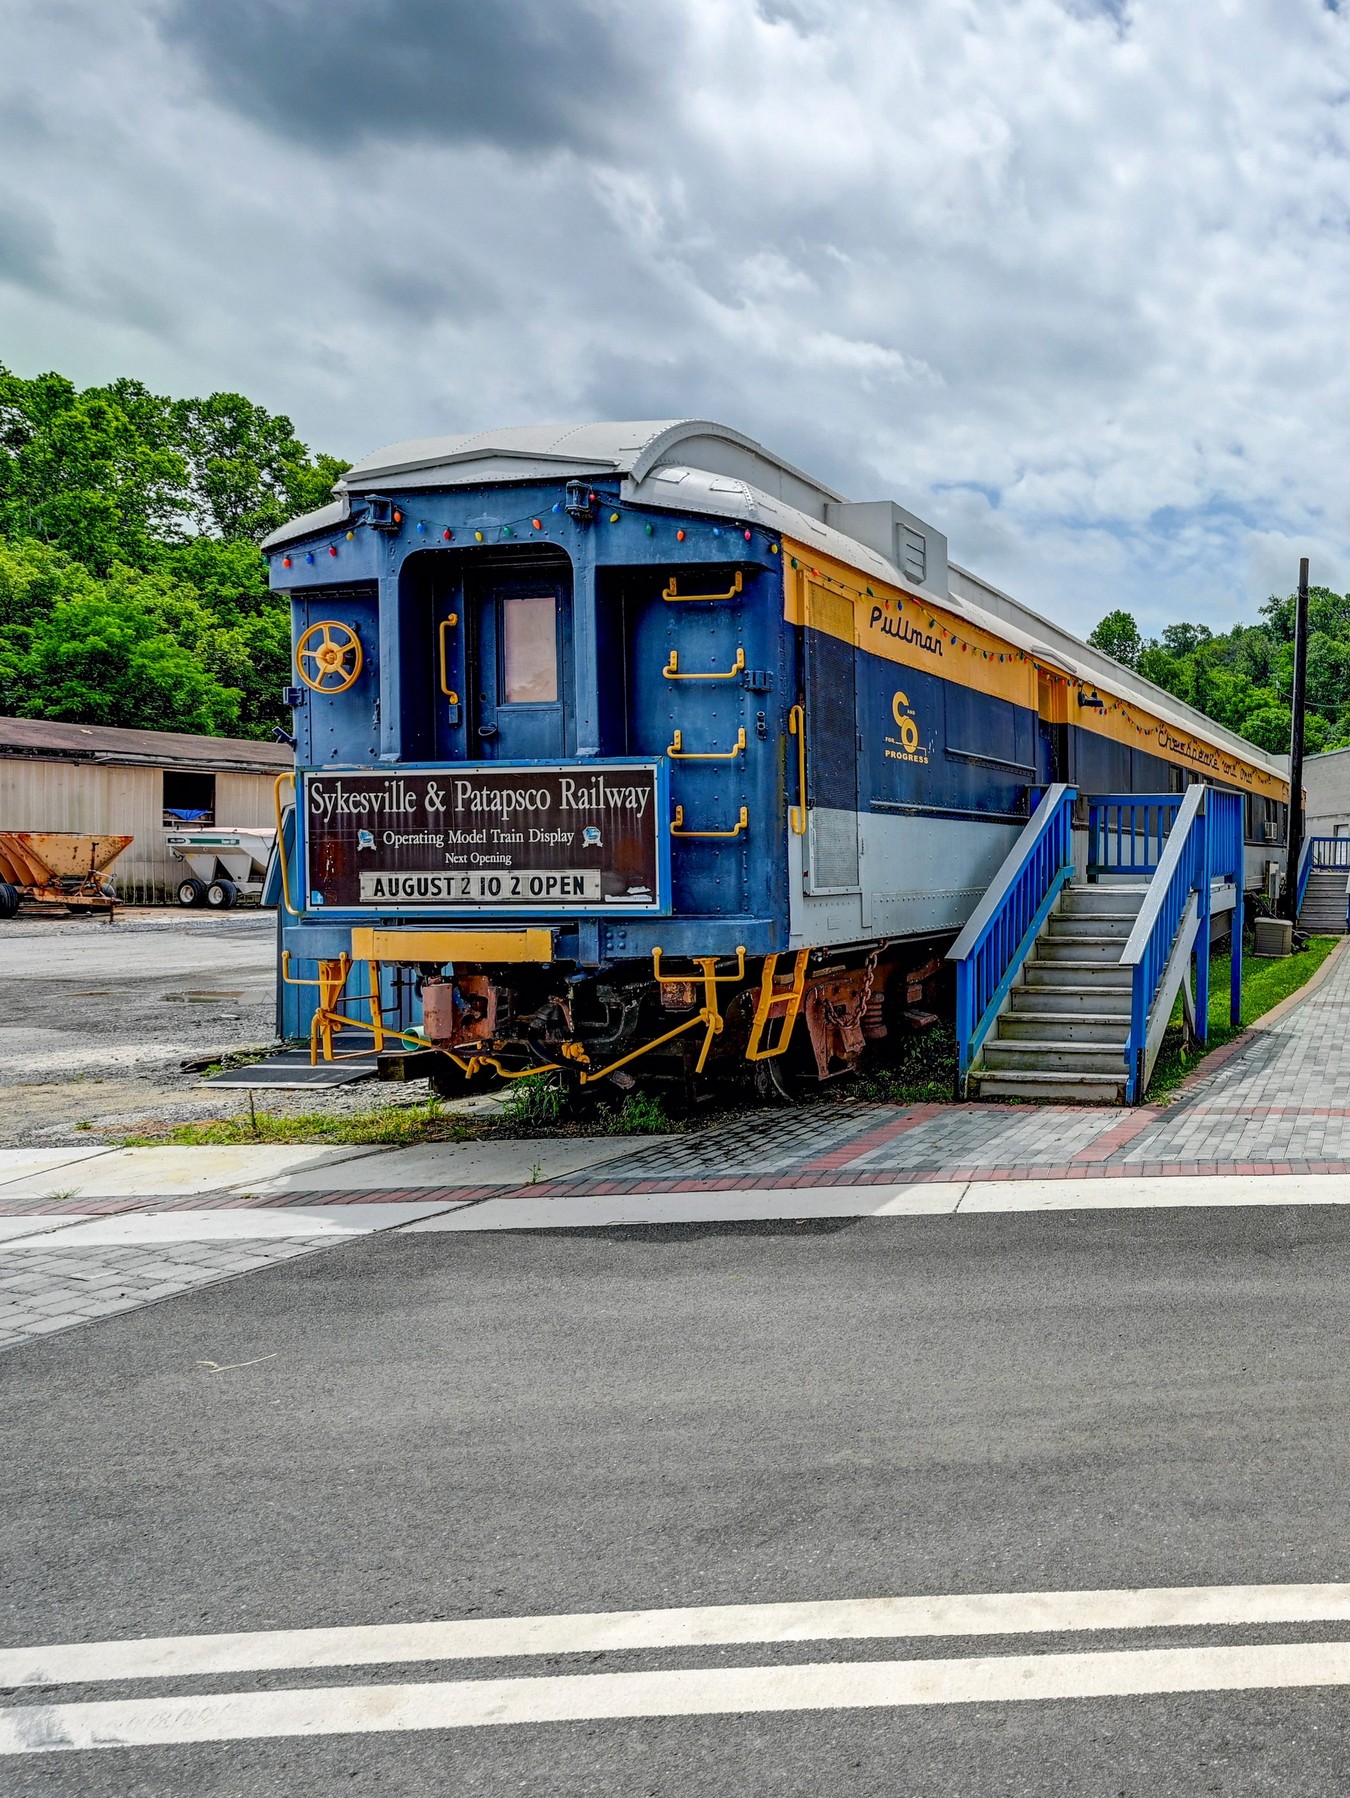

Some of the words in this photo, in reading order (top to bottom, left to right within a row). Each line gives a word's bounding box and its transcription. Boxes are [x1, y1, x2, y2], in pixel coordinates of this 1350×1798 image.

[869, 605, 944, 657] Pullman
[885, 736, 896, 744] FOR
[884, 749, 929, 765] PROGRESS
[311, 780, 417, 823] Sykesville
[424, 780, 447, 812] &
[454, 780, 551, 820] Patapsco
[559, 775, 651, 818] Railway
[383, 830, 445, 848] Operating
[447, 828, 487, 844] Model
[490, 828, 524, 843] Train
[528, 827, 575, 847] Display
[445, 852, 468, 864] Next
[470, 851, 512, 866] Opening
[373, 876, 455, 897] AUGUST
[461, 877, 471, 895] 2
[480, 876, 501, 896] 10
[510, 876, 521, 896] 2
[530, 875, 585, 896] OPEN
